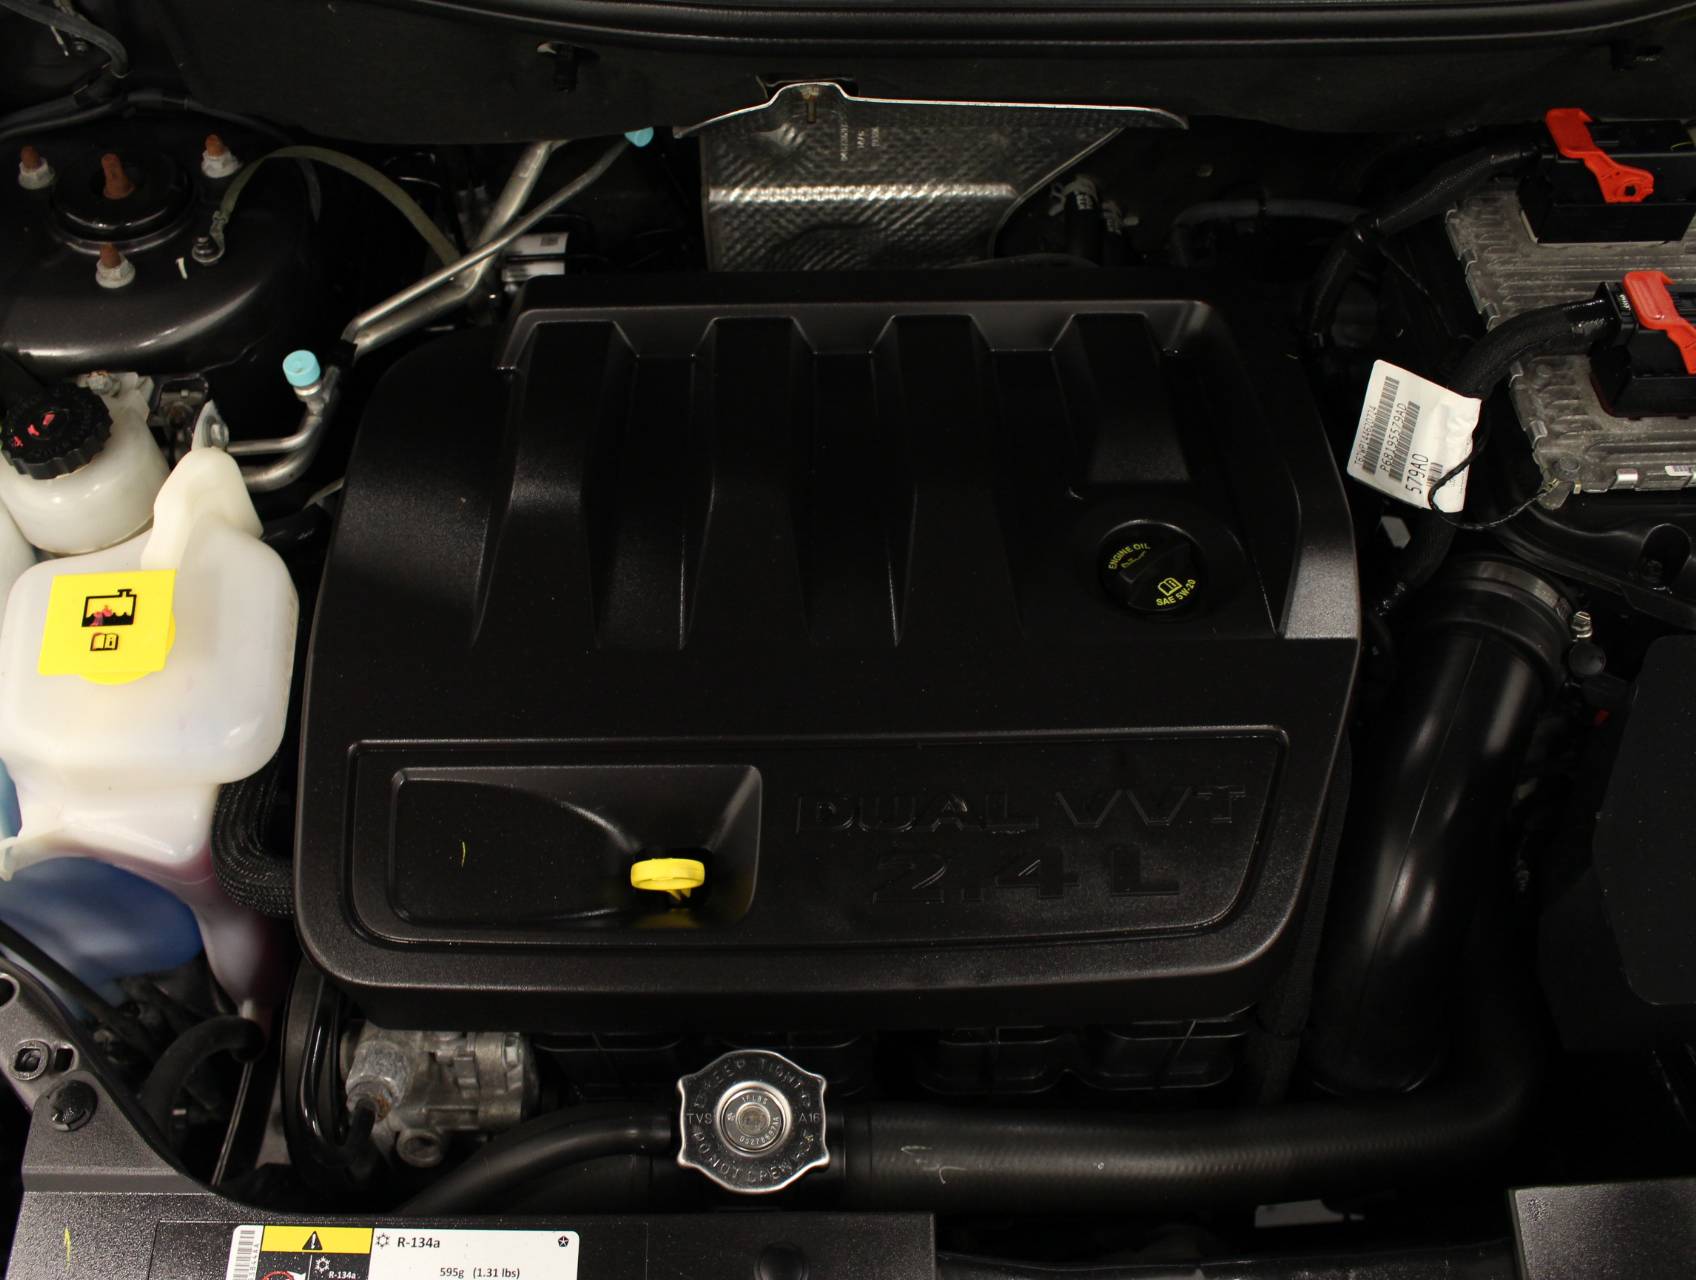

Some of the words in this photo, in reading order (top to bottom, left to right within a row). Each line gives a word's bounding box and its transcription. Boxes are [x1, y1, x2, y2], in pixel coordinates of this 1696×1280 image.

[1379, 402, 1408, 473] P68195579AD
[1405, 453, 1429, 494] 579AD
[1108, 546, 1133, 569] ENGINE
[1133, 543, 1152, 551] OIL
[1156, 596, 1176, 606] SAE
[1175, 579, 1196, 601] 5W-20
[796, 790, 1040, 833] DUAL
[1055, 786, 1247, 829] VVT
[871, 844, 1181, 905] 2.4L
[686, 1112, 713, 1125] TVS
[396, 1236, 441, 1249] R-134a
[328, 1270, 357, 1279] R-134a
[439, 1267, 465, 1279] 595g
[473, 1267, 499, 1280] (1.31
[501, 1267, 521, 1280] lbs)
